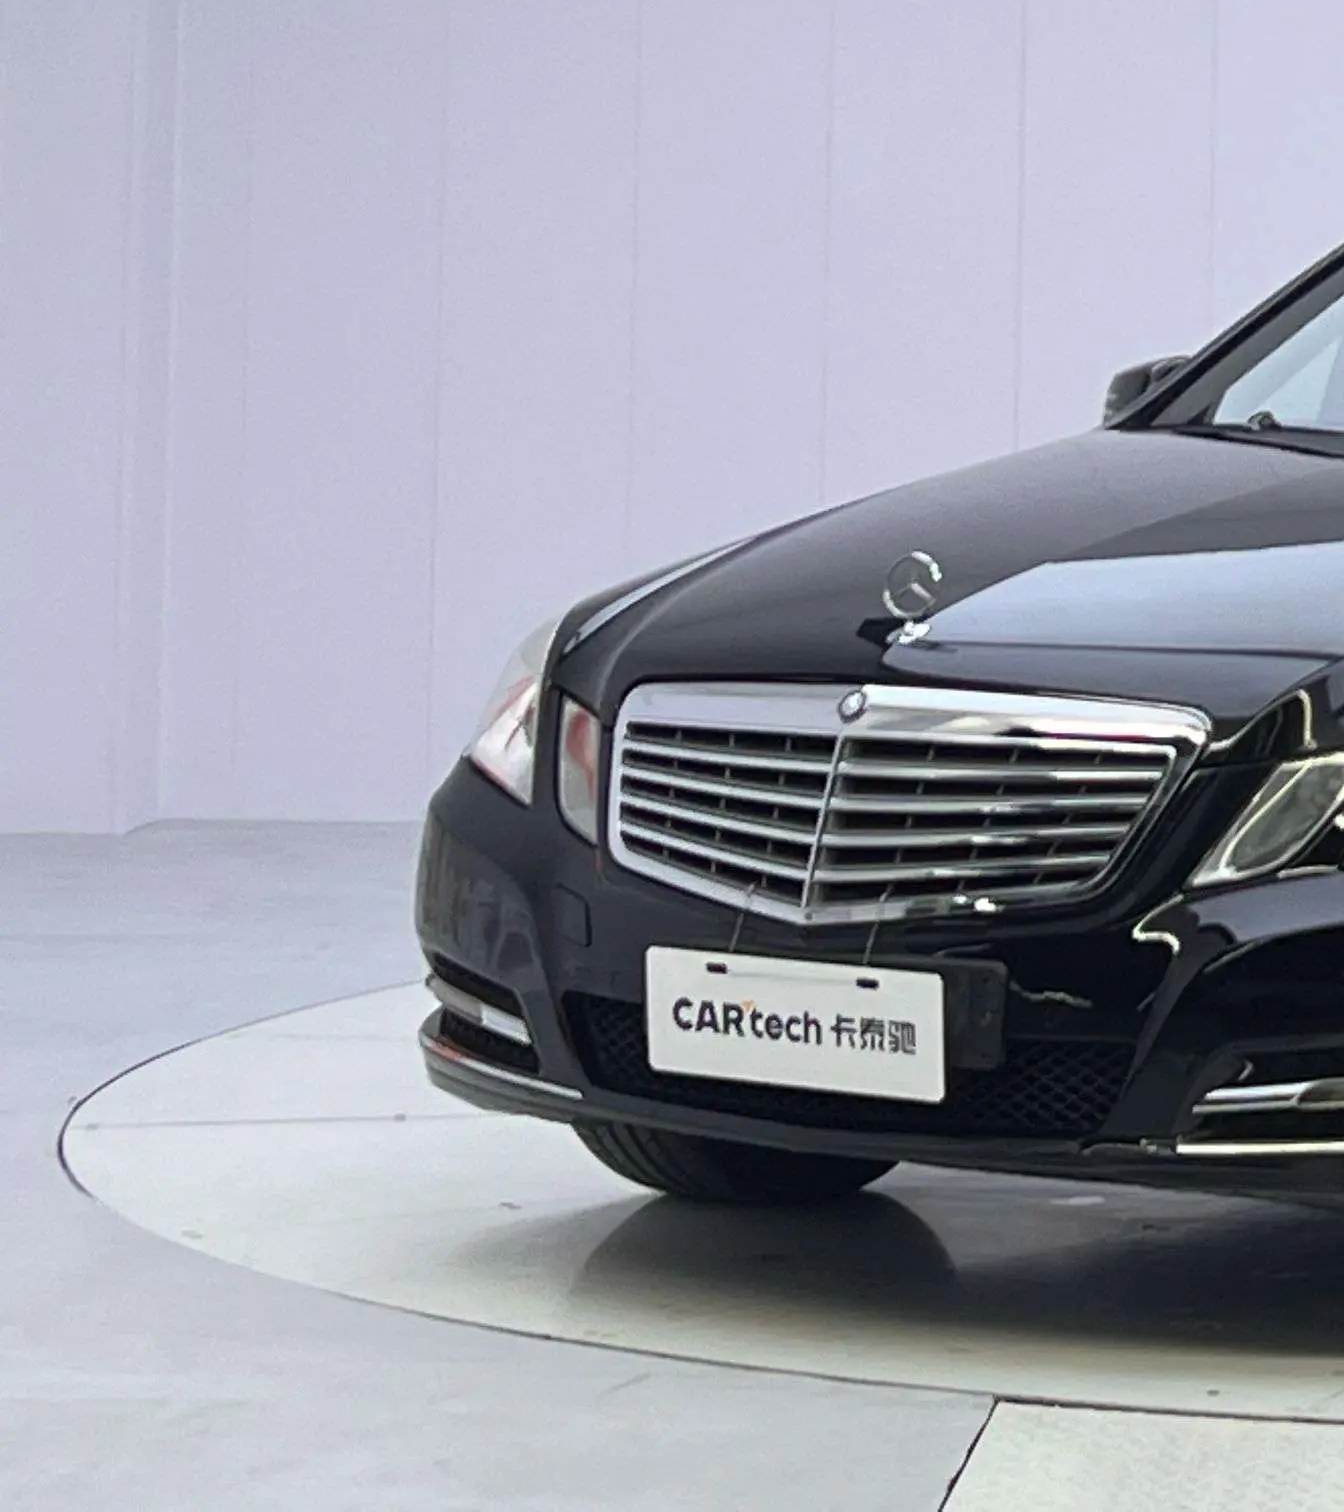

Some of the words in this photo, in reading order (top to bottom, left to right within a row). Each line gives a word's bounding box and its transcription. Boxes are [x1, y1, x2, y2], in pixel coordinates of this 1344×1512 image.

[672, 996, 823, 1046] CARtech
[830, 1012, 917, 1055] 卡泰驰
